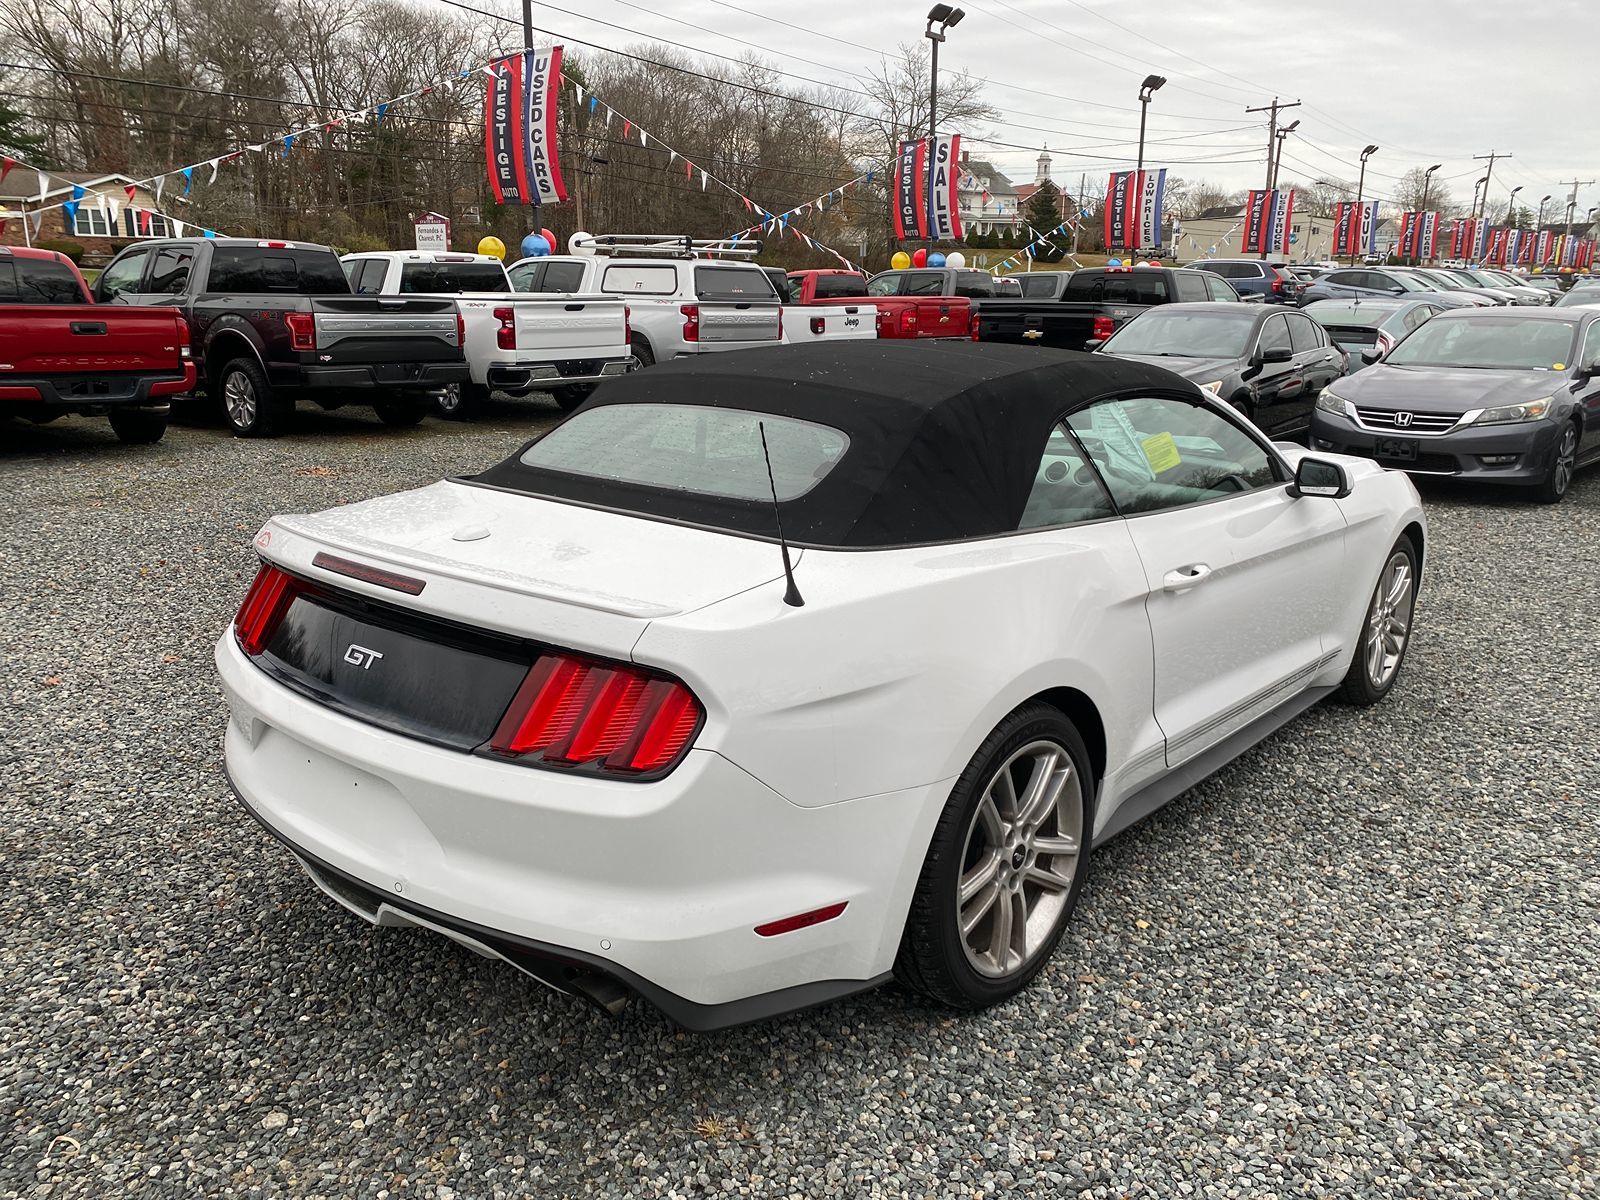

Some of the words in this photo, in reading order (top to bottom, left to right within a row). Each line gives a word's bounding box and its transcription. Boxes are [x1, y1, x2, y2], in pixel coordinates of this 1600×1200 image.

[530, 57, 548, 123] USED
[495, 64, 511, 180] PRESTIGE
[530, 128, 551, 194] CARS
[502, 187, 519, 197] AUTO
[902, 145, 914, 225] PRESTIGE
[934, 142, 950, 233] SALE
[1144, 175, 1155, 196] LOW
[1113, 176, 1126, 237] PRESTIGE
[1143, 199, 1152, 242] PRICES
[1250, 193, 1263, 243] PRESTIGE
[1277, 194, 1287, 216] USED
[1274, 217, 1283, 251] TRUCKS
[1361, 206, 1371, 249] SUV
[1425, 214, 1433, 235] USED
[1423, 235, 1431, 256] CARS
[706, 315, 776, 324] CHEVROLET
[844, 317, 859, 327] Jeep
[36, 357, 144, 365] TACOMA
[344, 644, 383, 670] GT
